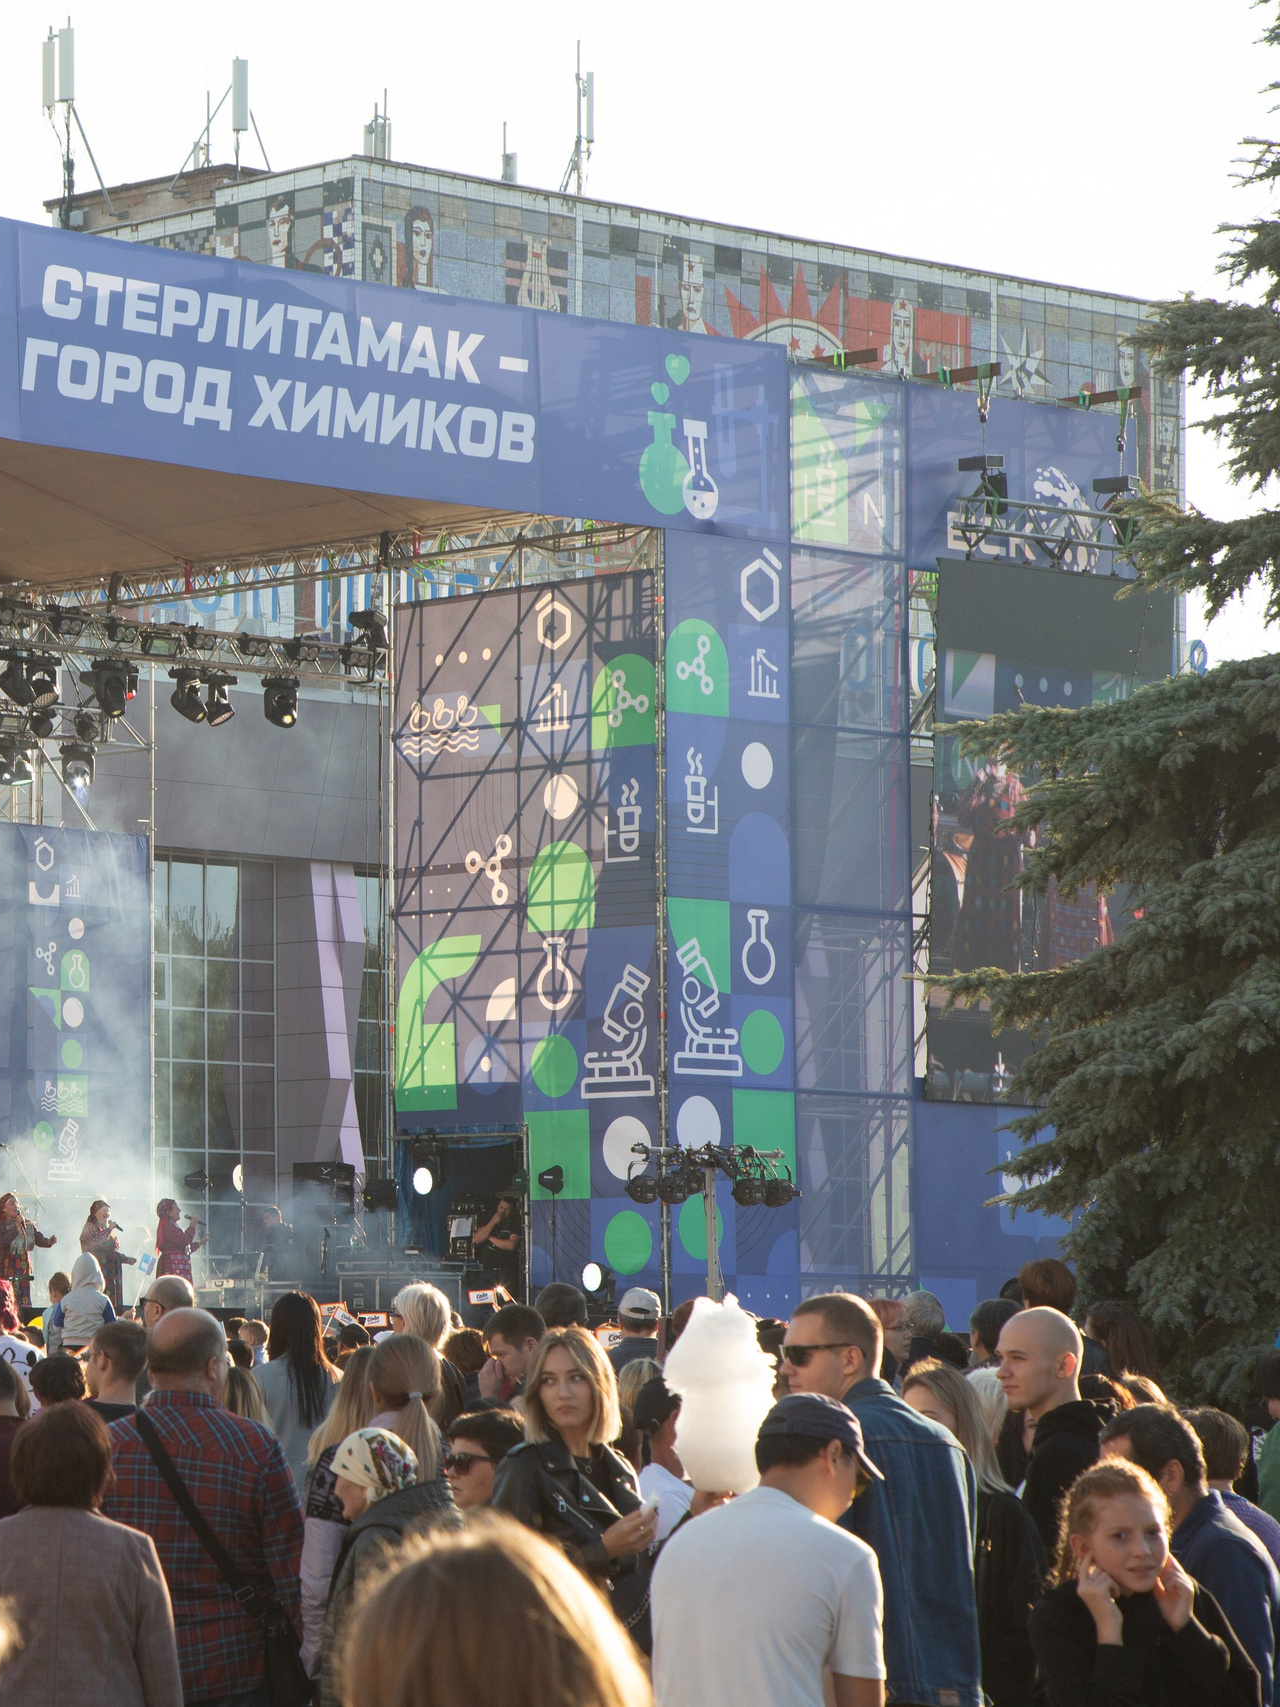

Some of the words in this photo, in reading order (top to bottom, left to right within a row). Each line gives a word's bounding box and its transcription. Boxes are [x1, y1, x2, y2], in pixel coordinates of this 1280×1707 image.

[42, 264, 485, 384] СТЕРЛИТАМАК
[22, 338, 233, 431] ГОРОД
[248, 375, 536, 464] ХИМИКОВ
